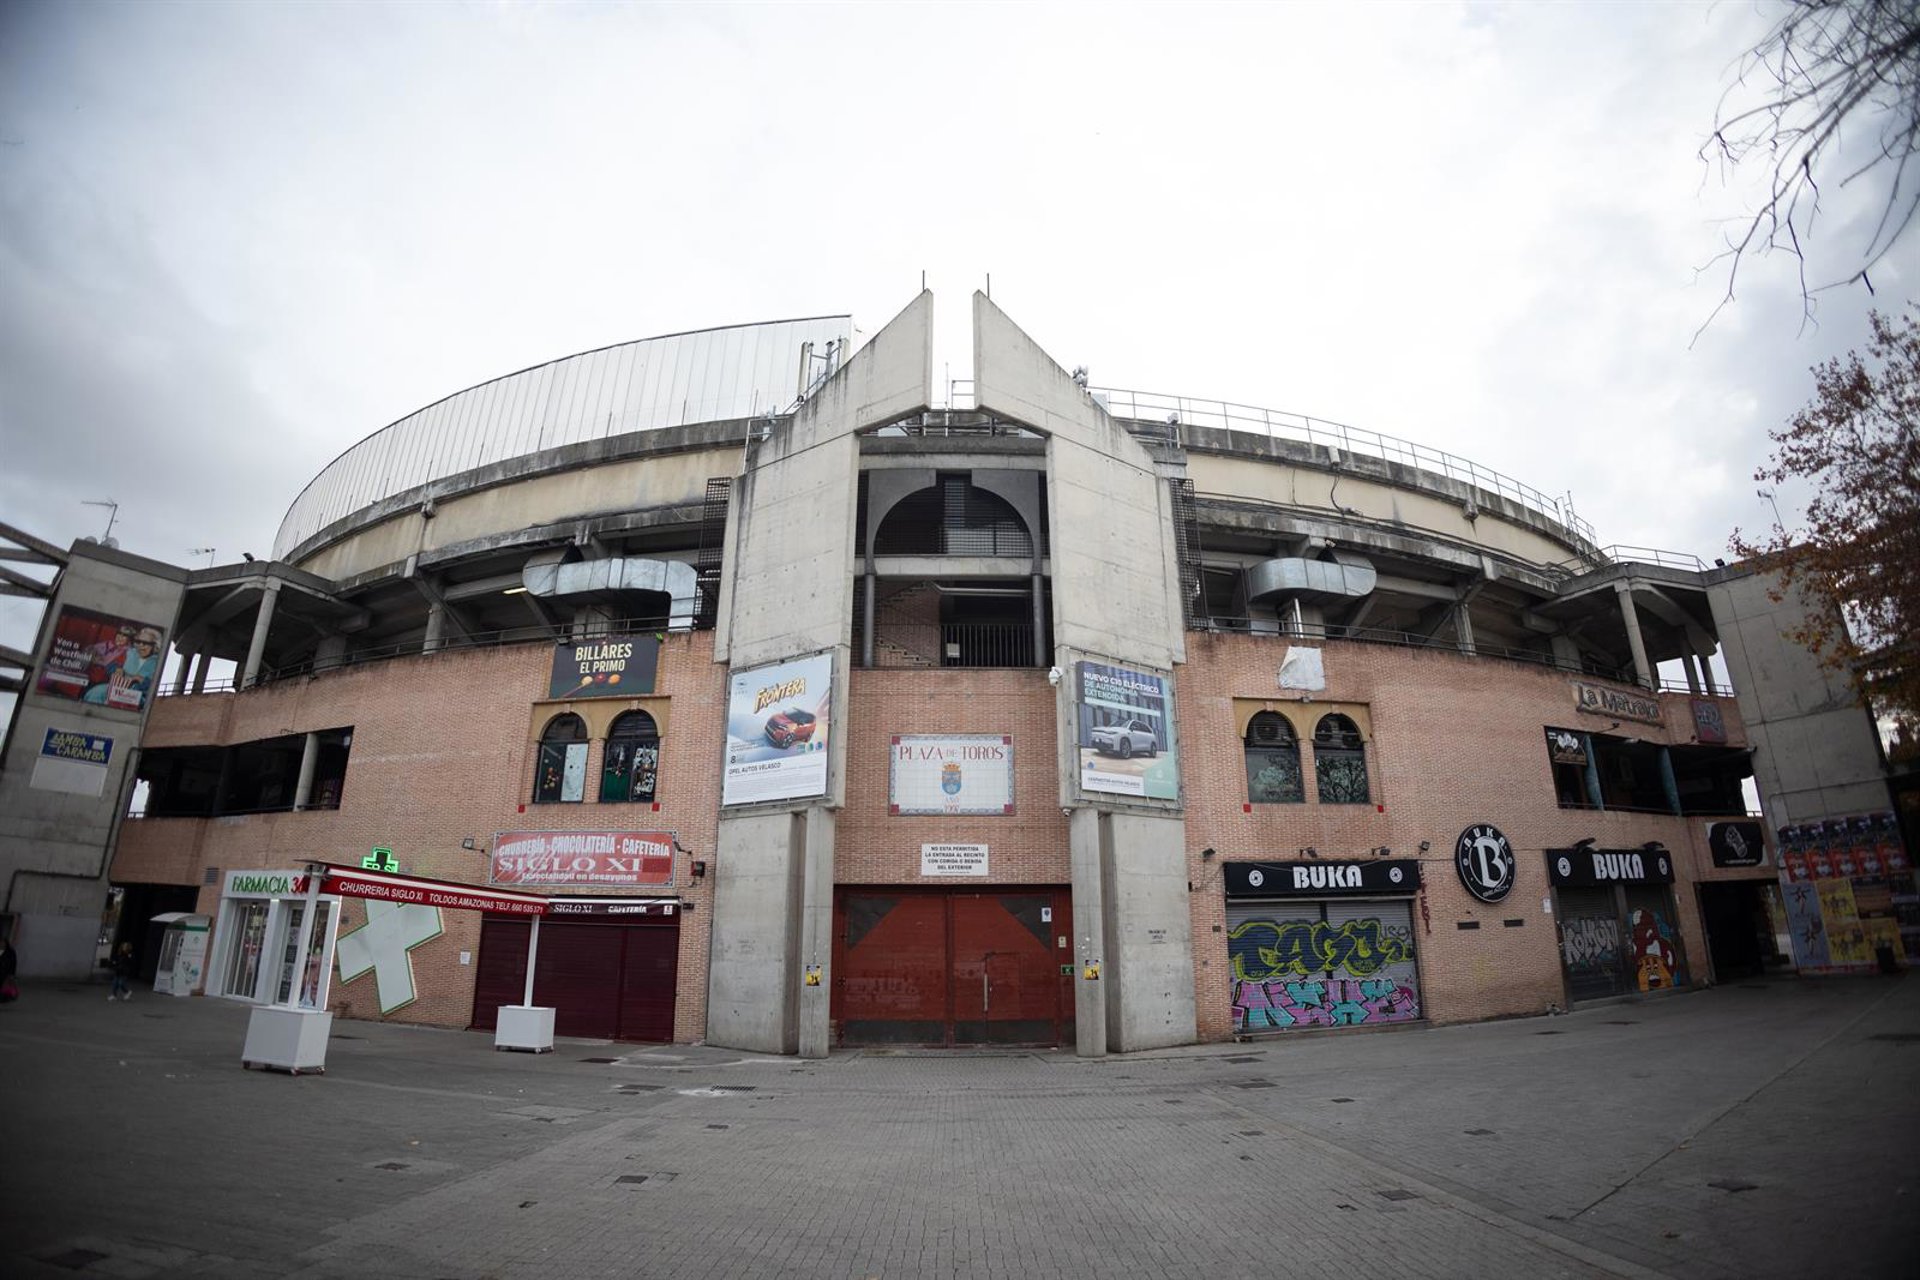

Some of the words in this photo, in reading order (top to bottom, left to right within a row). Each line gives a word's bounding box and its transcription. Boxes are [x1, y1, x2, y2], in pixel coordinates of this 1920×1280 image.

[56, 637, 73, 648] Ven
[53, 646, 93, 661] Westfield
[575, 643, 633, 662] BILLARES
[50, 656, 61, 665] de
[579, 662, 591, 674] EL
[592, 659, 626, 673] PRIMO
[1083, 671, 1109, 684] NUEVO
[1084, 680, 1095, 688] DE
[753, 677, 806, 714] FRONTERA
[1578, 684, 1599, 708] La
[900, 746, 943, 760] PLAZA
[960, 746, 1004, 760] TOROS
[728, 766, 741, 775] OPEL
[741, 764, 758, 773] AUTOS
[758, 762, 782, 772] VELASCO
[552, 833, 616, 855] CHOCOLATERÍA
[622, 838, 671, 857] CAFETERÍA
[498, 857, 596, 872] SIGLO
[606, 857, 643, 872] XI
[1592, 853, 1645, 880] BUKA
[589, 872, 638, 883] desayunos
[1292, 865, 1364, 889] BUKA
[231, 876, 291, 895] FARMACIA
[390, 888, 415, 901] SIGLO
[415, 891, 424, 902] XI
[429, 893, 458, 906] TOLDOS
[458, 896, 496, 910] AMAZONAS
[553, 904, 581, 914] SIGLO
[581, 904, 594, 914] XI
